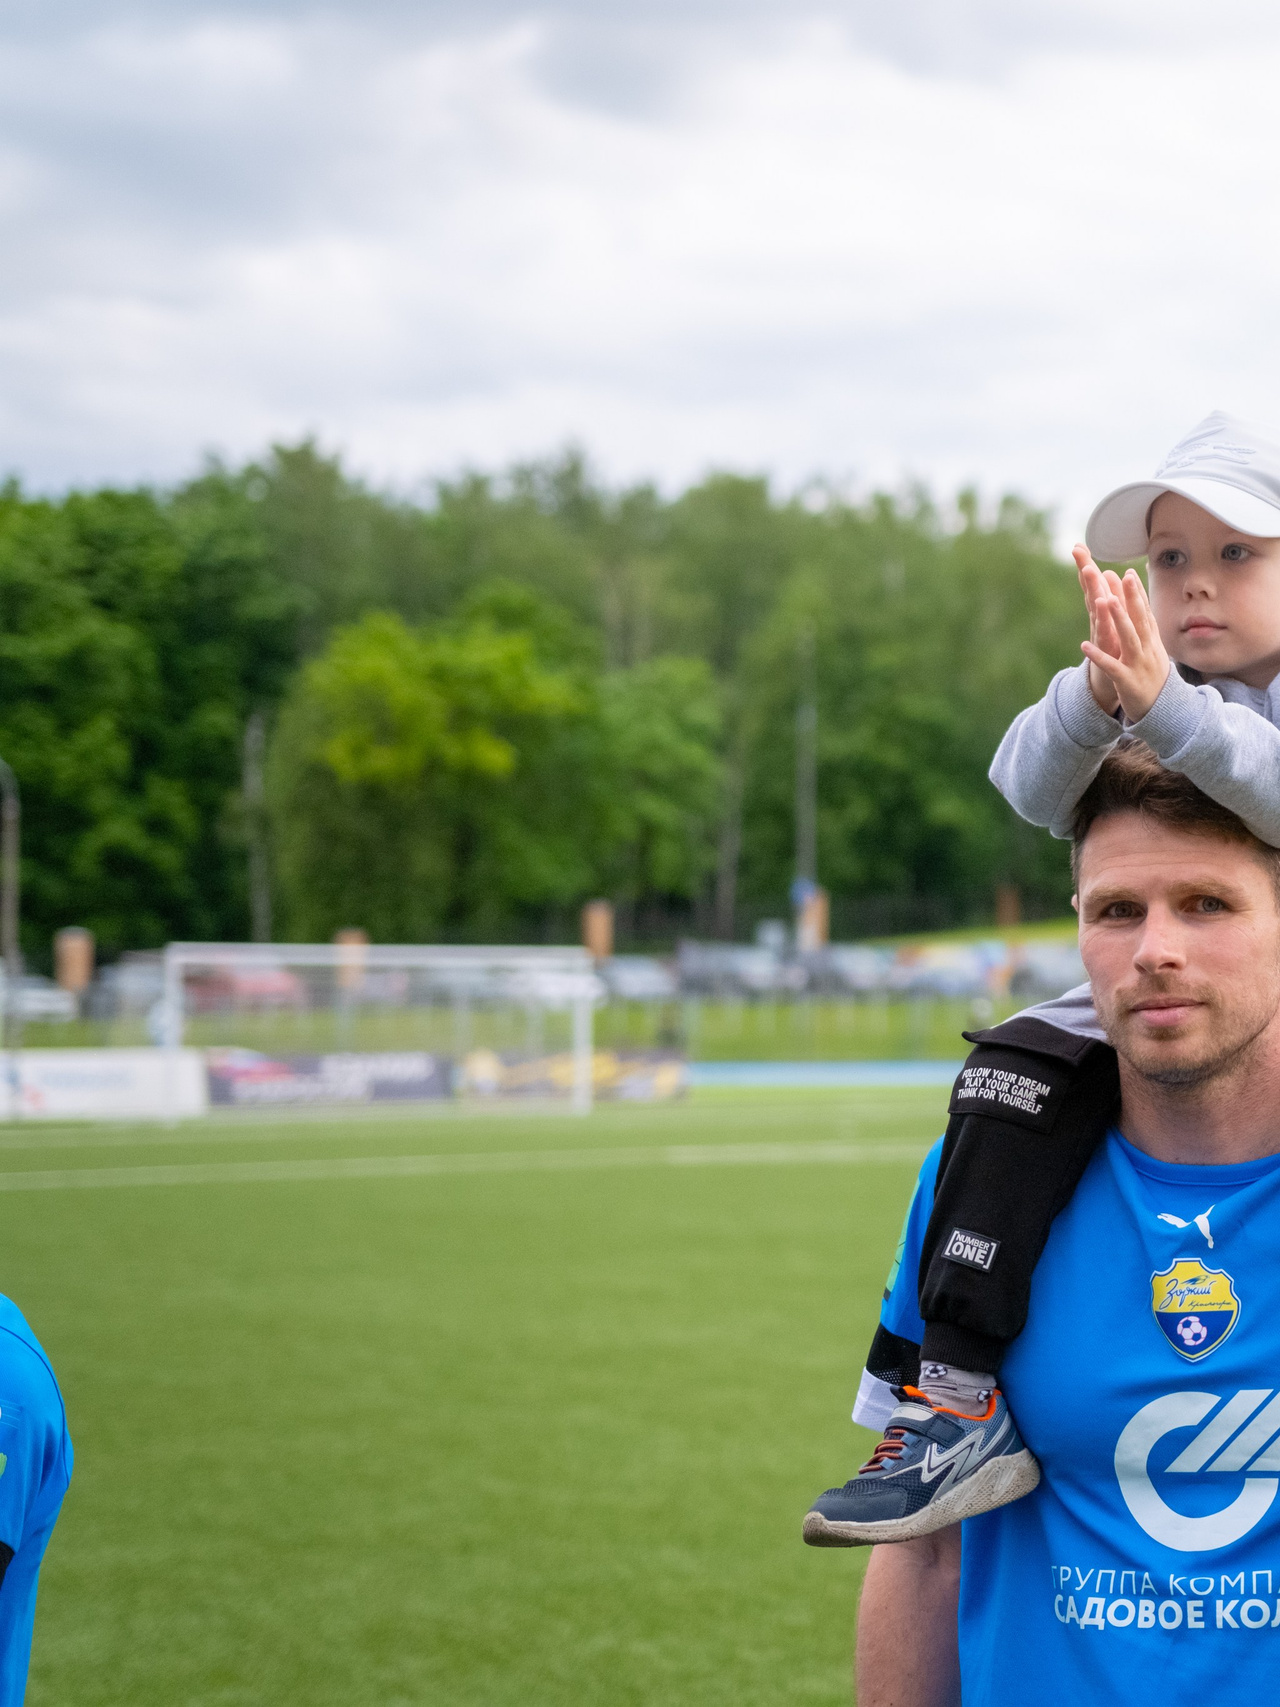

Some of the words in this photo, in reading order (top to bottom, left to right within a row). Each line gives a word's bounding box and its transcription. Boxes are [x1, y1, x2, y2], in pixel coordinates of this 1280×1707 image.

[962, 1067, 990, 1079] FOLLOW
[993, 1069, 1017, 1083] YOUR
[1018, 1076, 1050, 1096] DREAM
[965, 1077, 984, 1088] PLAY
[986, 1079, 1010, 1092] YOUR
[1011, 1085, 1038, 1102] GAME
[957, 1088, 978, 1099] THINK
[979, 1088, 996, 1099] FOR
[998, 1093, 1042, 1114] YOURSELF
[952, 1242, 987, 1264] ONE
[956, 1234, 989, 1250] NUMBER
[1051, 1565, 1159, 1596] ГРУППА
[1054, 1594, 1206, 1631] САДОВОЕ
